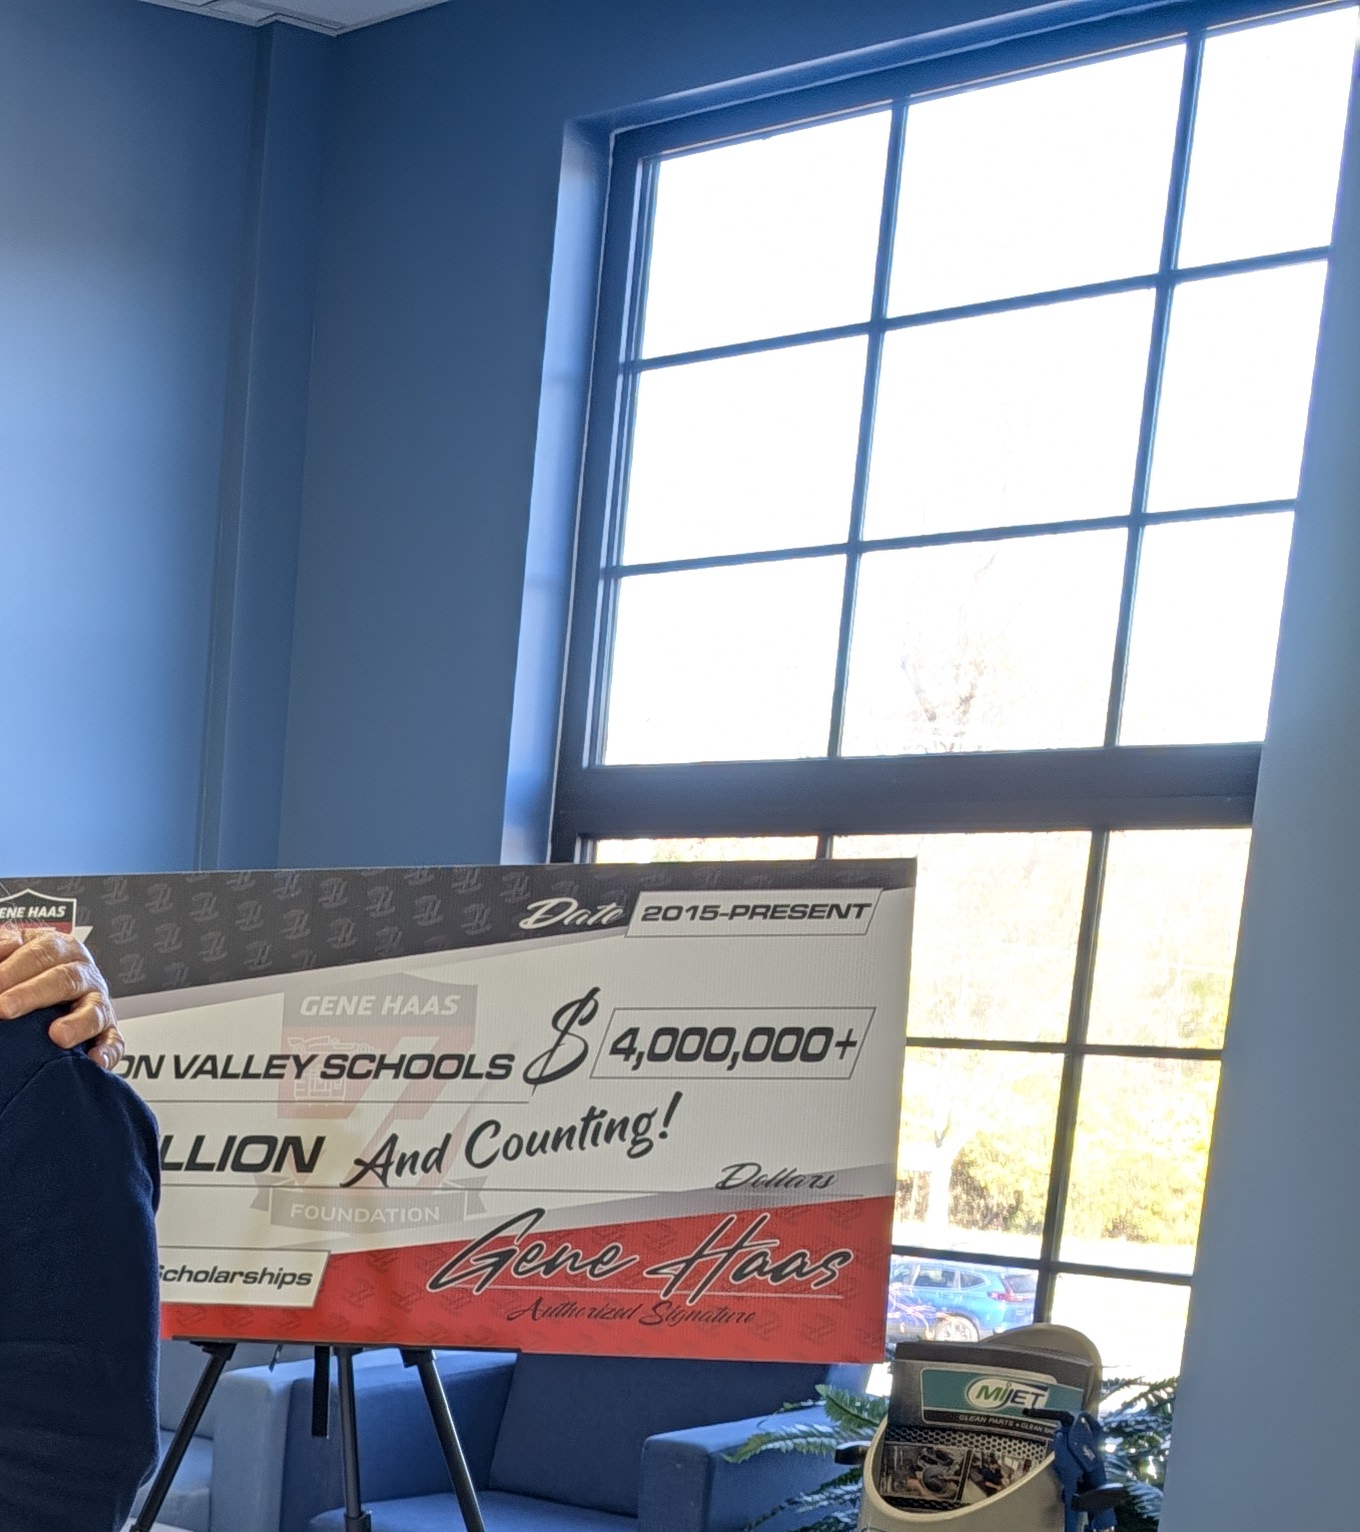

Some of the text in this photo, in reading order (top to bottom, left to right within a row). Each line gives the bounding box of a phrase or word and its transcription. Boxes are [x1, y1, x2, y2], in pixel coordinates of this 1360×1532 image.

[28, 906, 66, 918] HAAS
[519, 897, 872, 930] Date 2015-PRESENT
[301, 994, 460, 1016] GENE HAAS
[180, 1054, 320, 1080] VALLEY
[319, 1053, 515, 1080] SCHOOLS
[608, 1027, 857, 1071] 4,000,000+
[339, 1132, 452, 1188] And
[465, 1091, 683, 1169] Counting!
[715, 1162, 839, 1191] Dollars
[290, 1203, 440, 1224] FOUNDATION
[427, 1208, 853, 1305] Gene Haas
[506, 1297, 756, 1327] Authorized Signature
[959, 1414, 987, 1423] CLEAN
[989, 1418, 1014, 1427] PARTS
